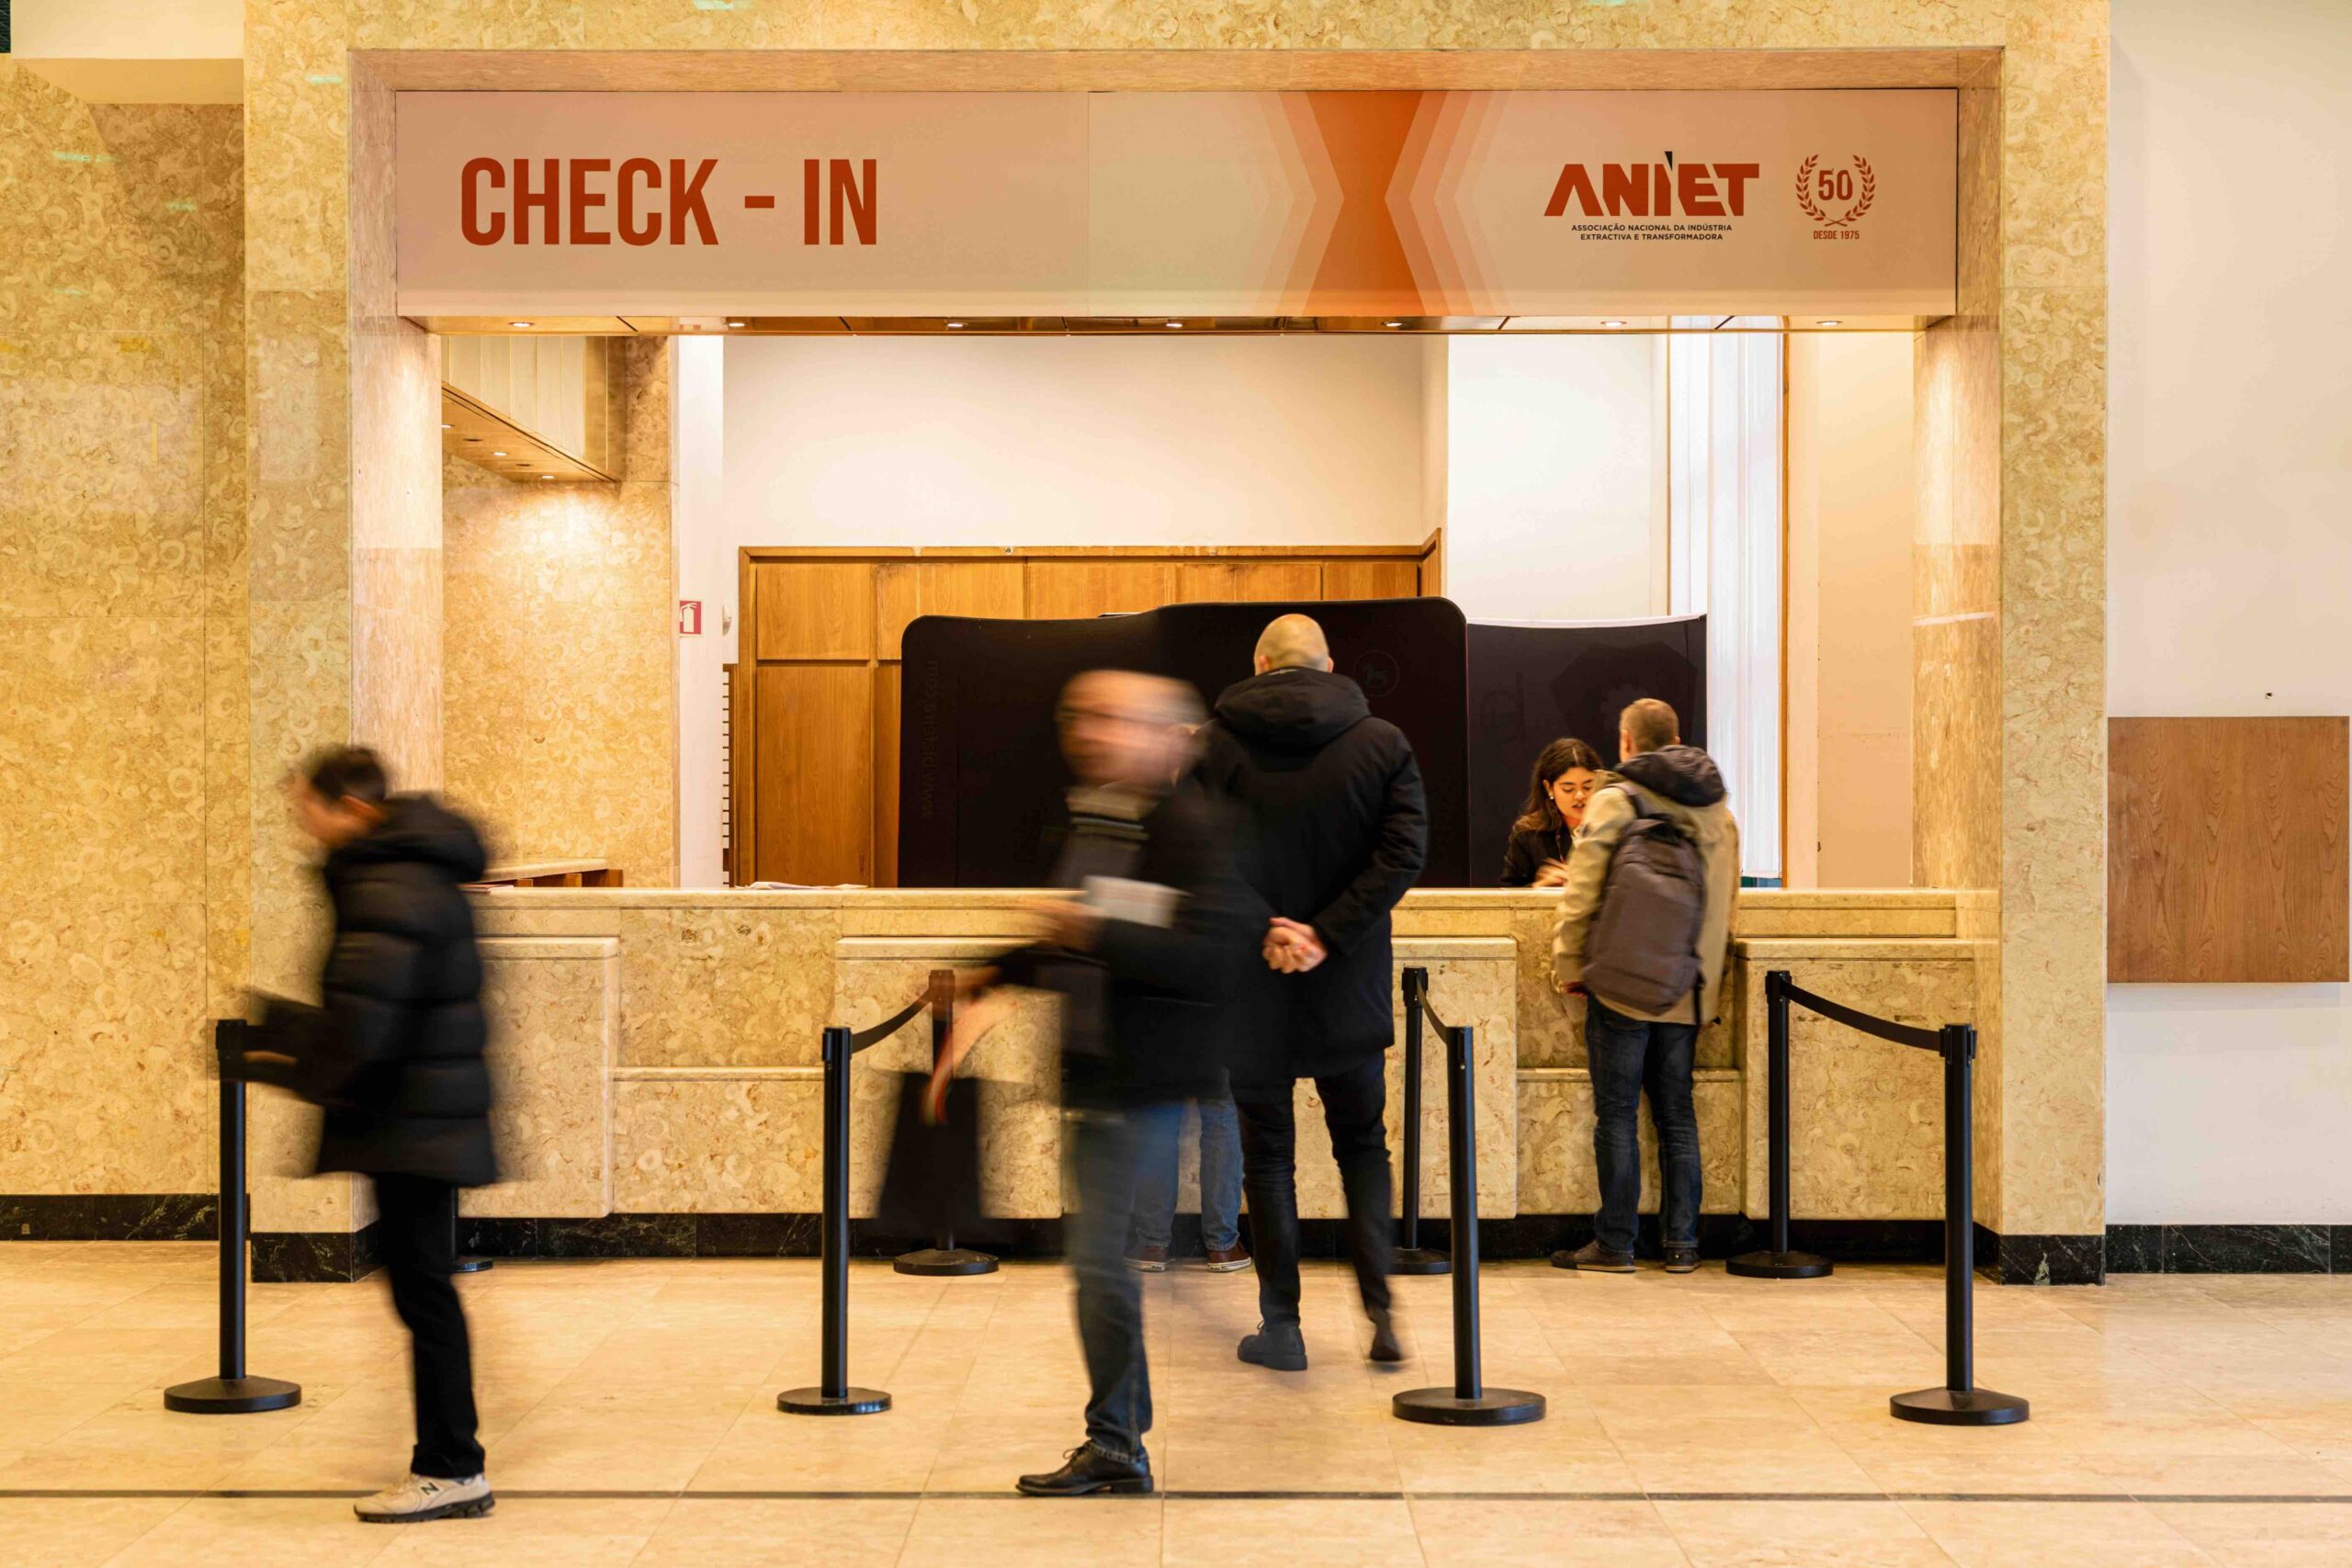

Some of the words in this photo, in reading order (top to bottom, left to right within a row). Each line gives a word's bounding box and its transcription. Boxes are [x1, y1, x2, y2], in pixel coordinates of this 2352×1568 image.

[1818, 168, 1853, 201] 50
[461, 157, 718, 246] CHECK
[804, 158, 877, 245] IN
[1571, 223, 1626, 231] ASSOCIAÇÃO
[1687, 223, 1733, 231] INDÚSTRIA
[1813, 230, 1838, 240] DESDE
[1840, 230, 1860, 240] 1975
[420, 1482, 439, 1495] N
